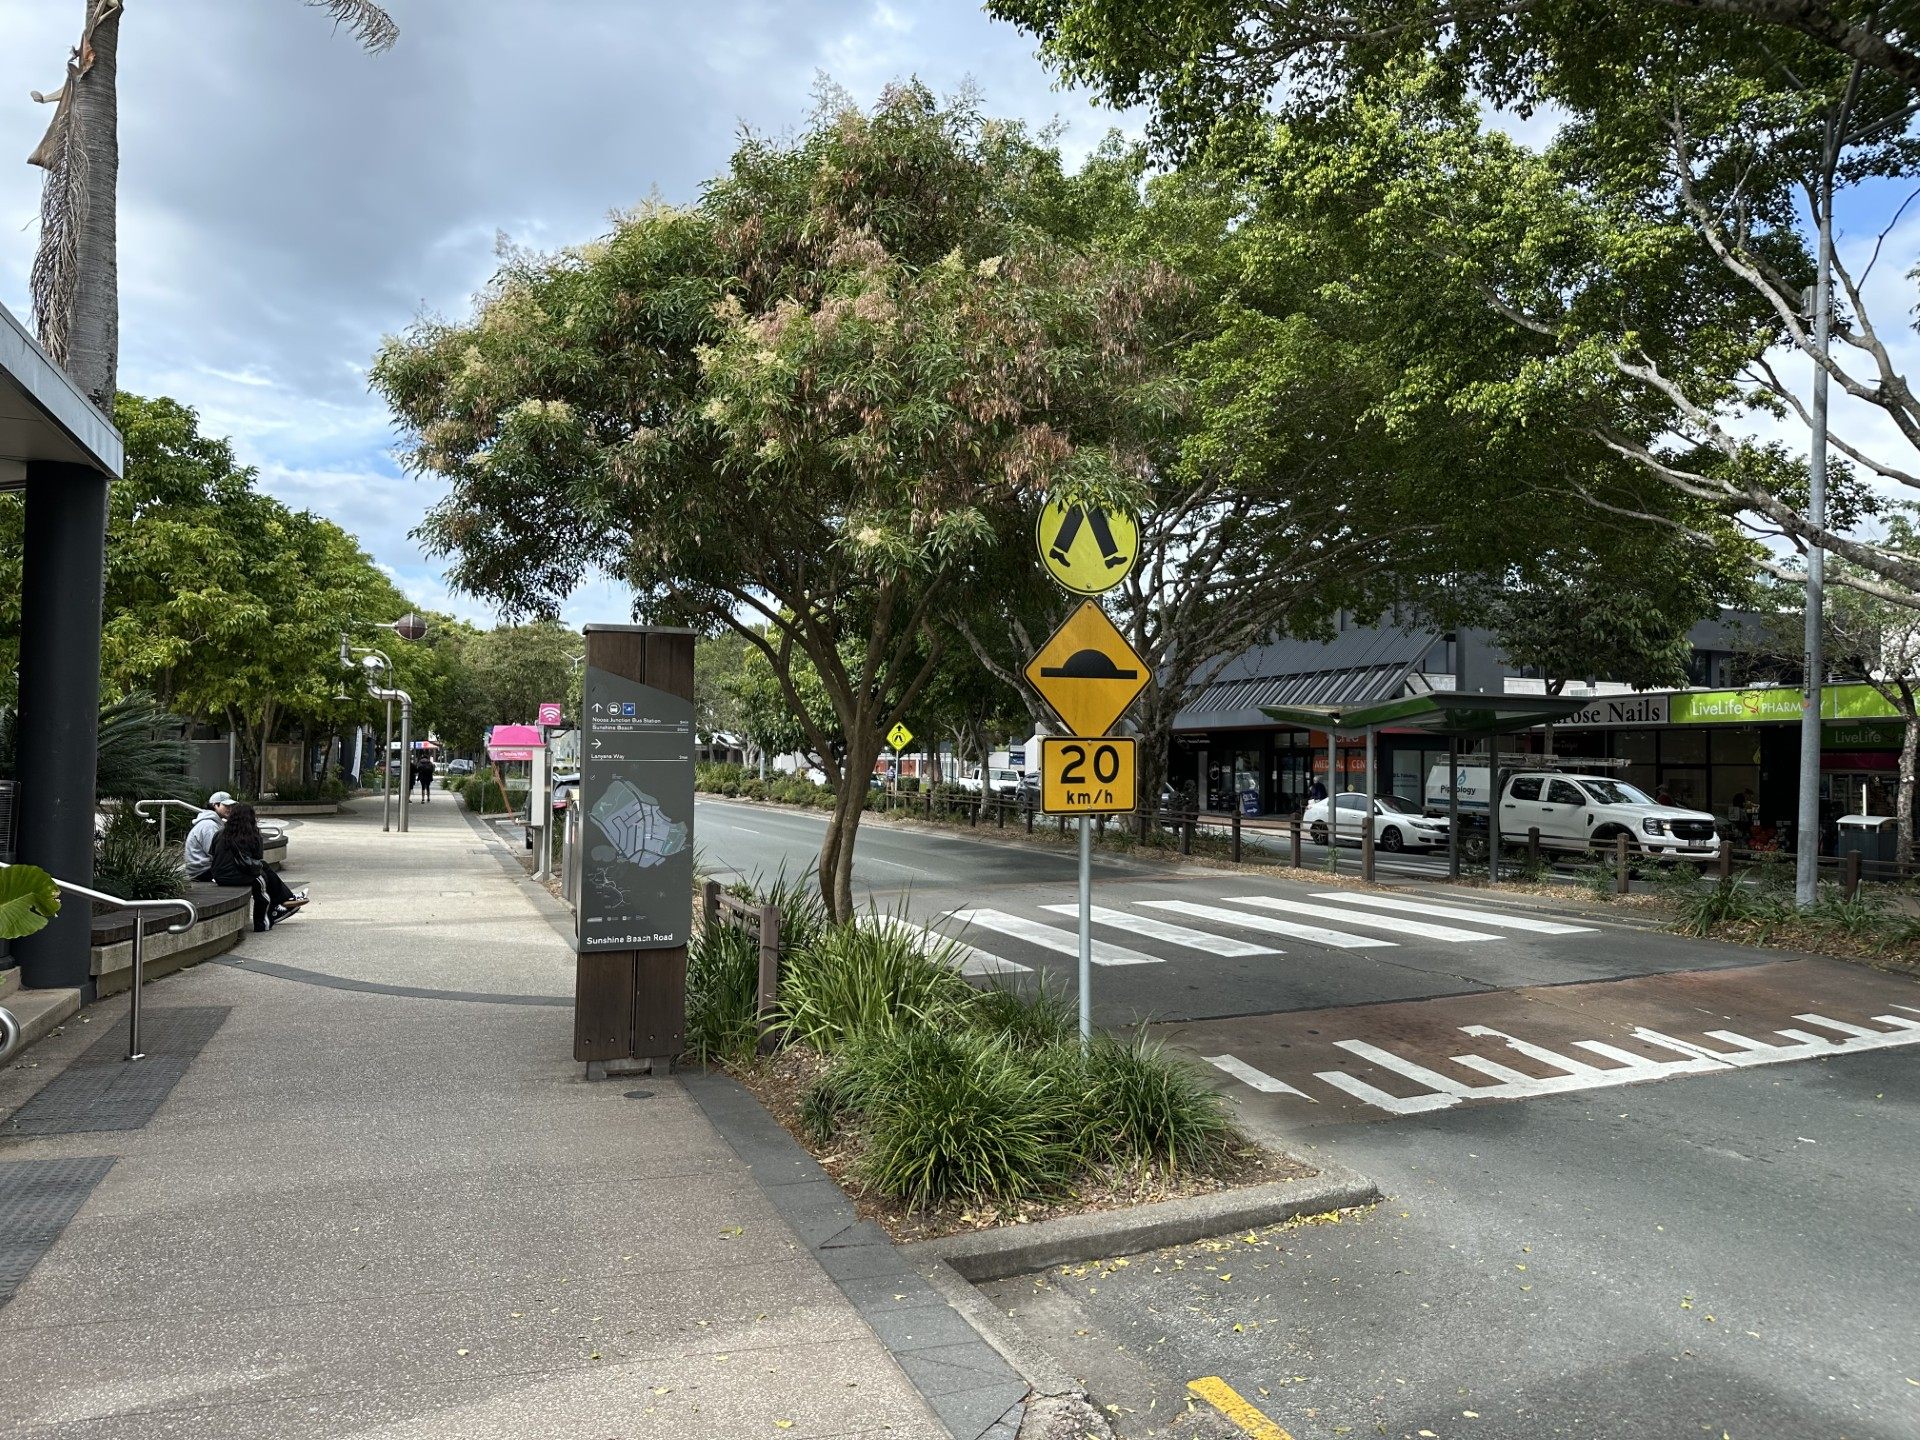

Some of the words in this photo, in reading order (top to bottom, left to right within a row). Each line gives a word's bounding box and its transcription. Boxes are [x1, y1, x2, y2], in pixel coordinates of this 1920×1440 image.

[1608, 699, 1660, 723] Nails
[1692, 700, 1743, 716] LiveLife
[1761, 700, 1826, 713] PHARMY
[1835, 730, 1882, 743] LiveLife
[1061, 745, 1120, 785] 20
[1314, 759, 1345, 769] MEDAL
[1351, 759, 1378, 769] CENE
[1066, 789, 1113, 805] km/h
[586, 936, 625, 945] Sunshine
[626, 934, 651, 943] Beach
[653, 933, 674, 941] Road
